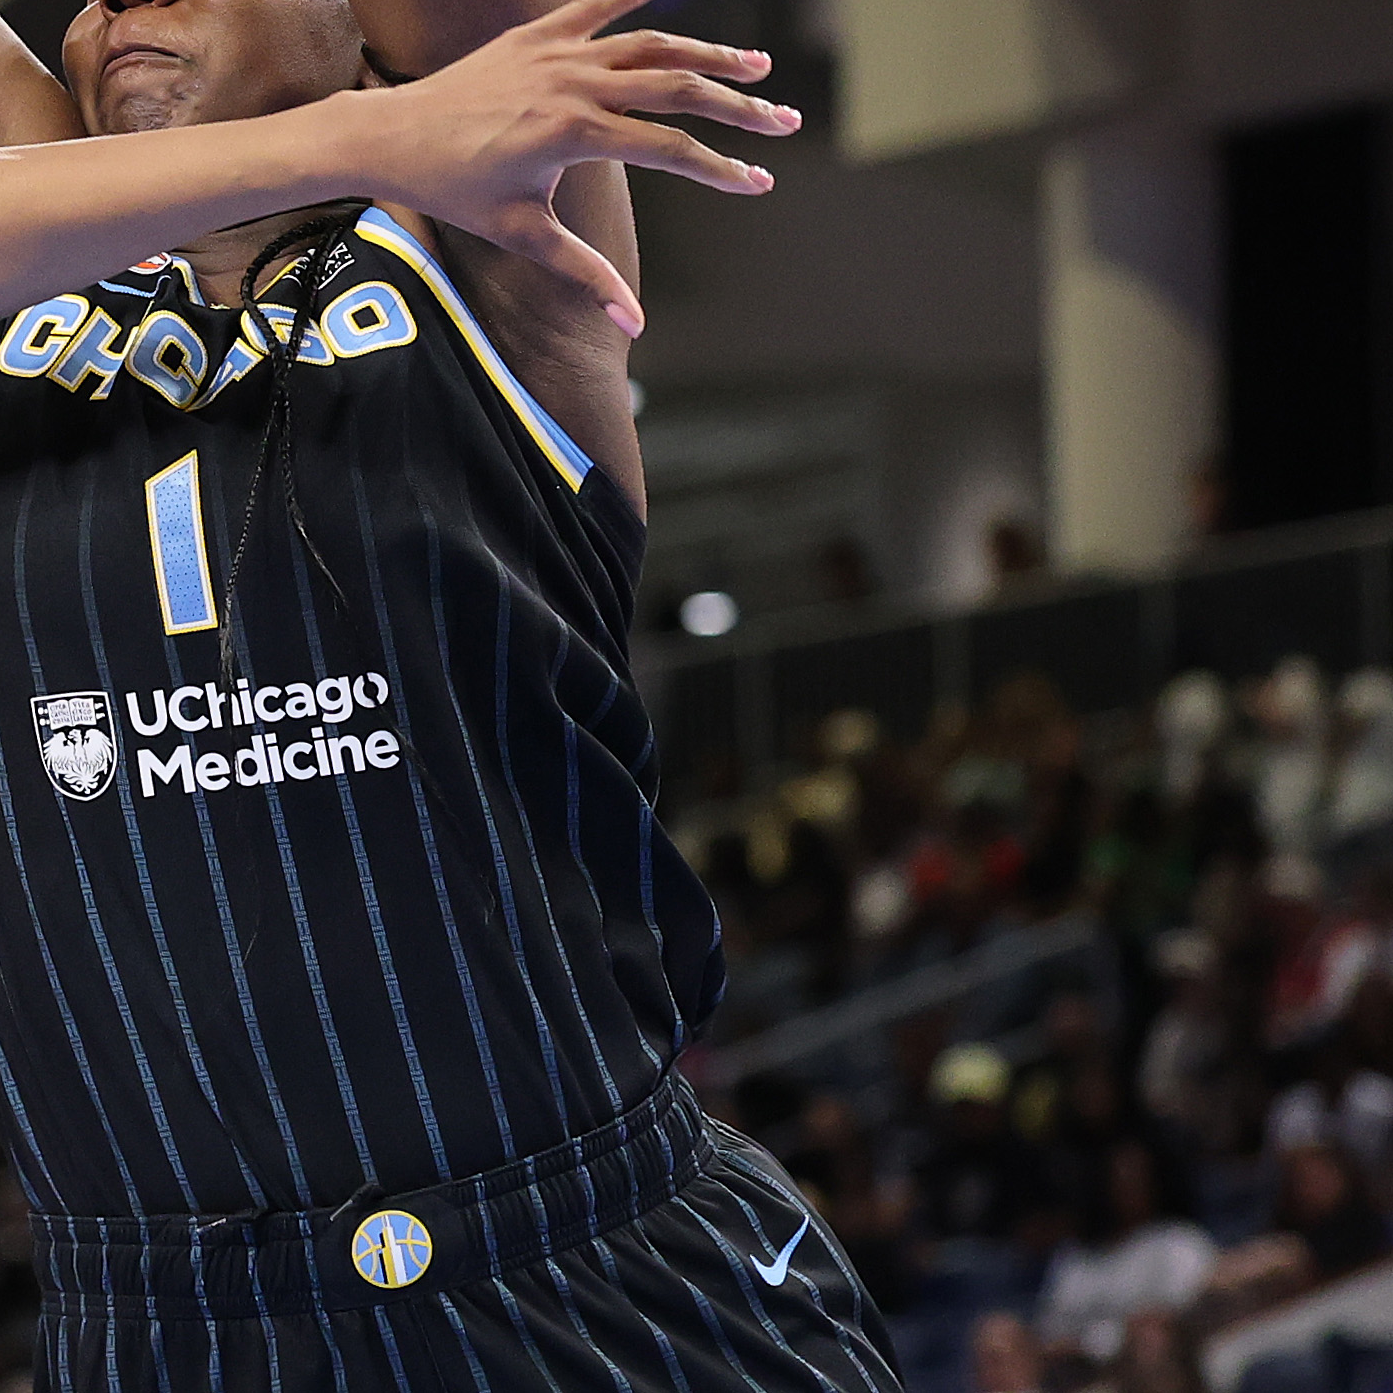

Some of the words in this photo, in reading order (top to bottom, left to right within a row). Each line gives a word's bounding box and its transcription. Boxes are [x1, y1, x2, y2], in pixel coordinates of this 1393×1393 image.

[145, 450, 218, 636] 1
[125, 672, 389, 737] UChicago
[136, 726, 401, 798] Medicine
